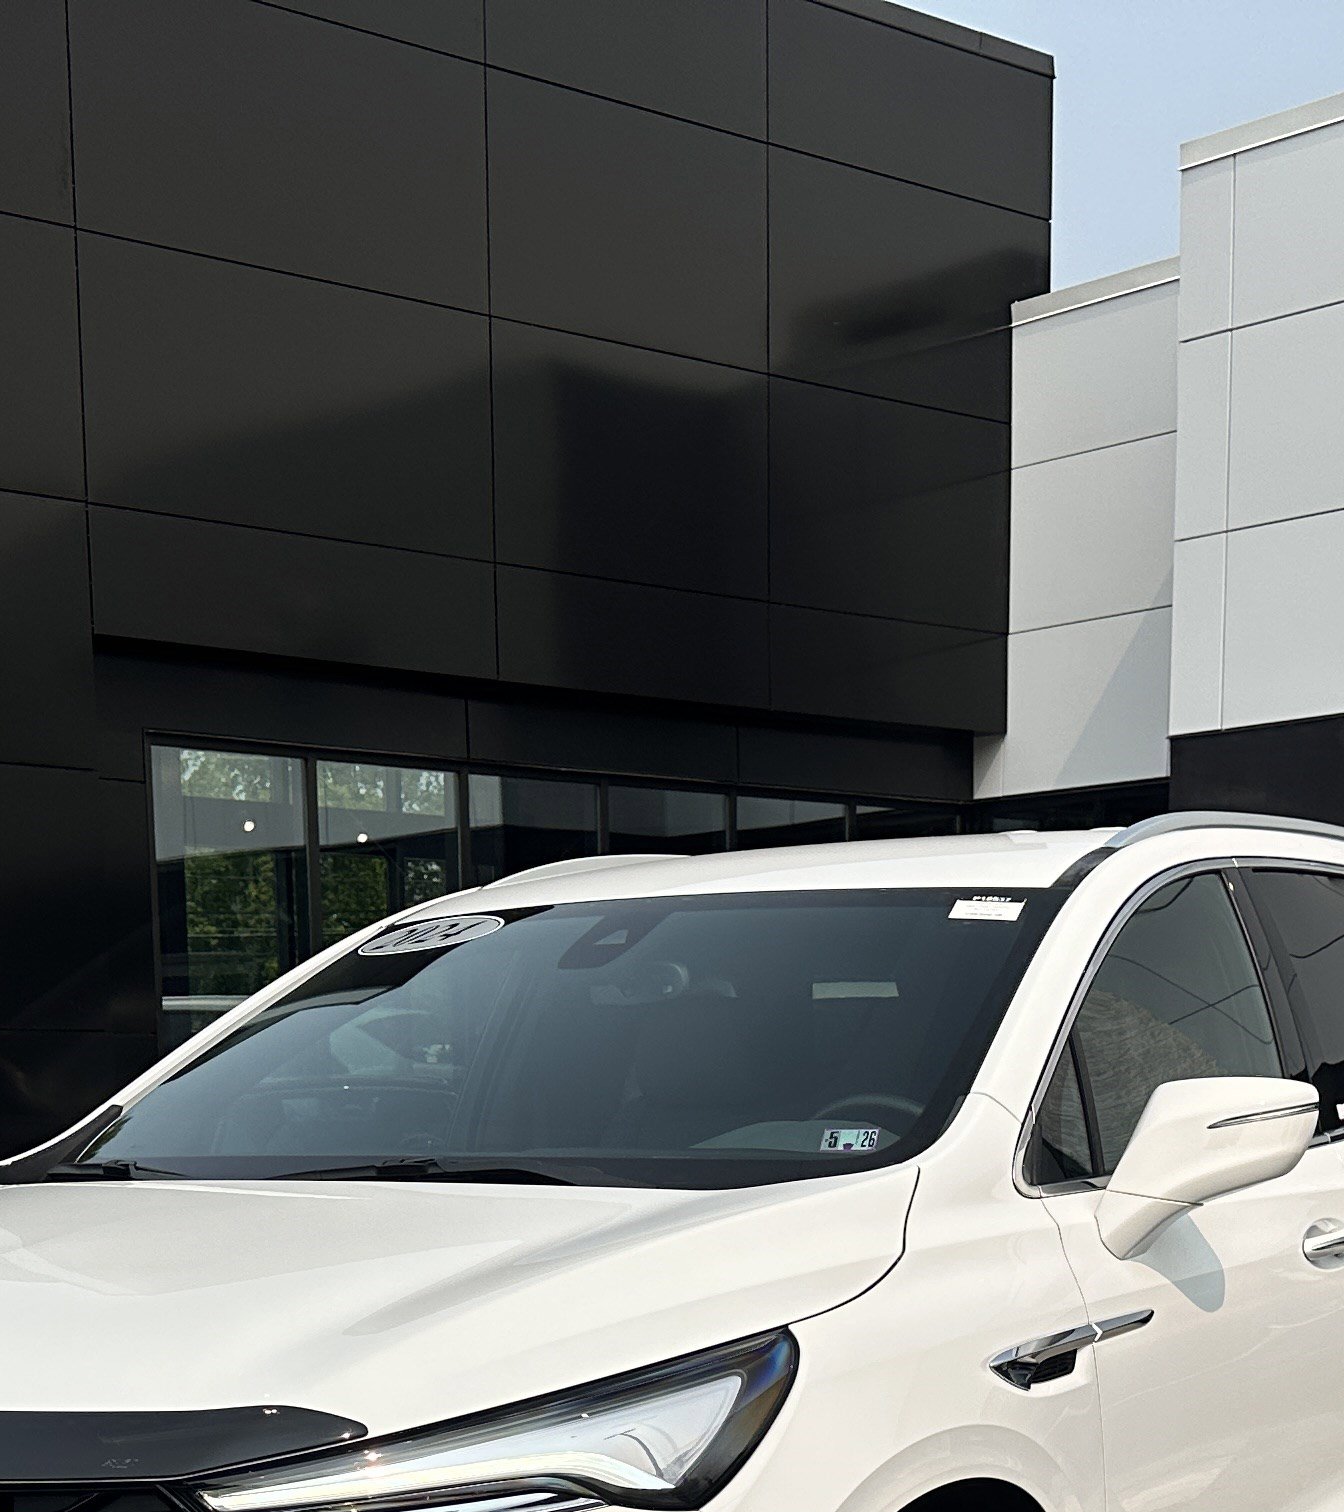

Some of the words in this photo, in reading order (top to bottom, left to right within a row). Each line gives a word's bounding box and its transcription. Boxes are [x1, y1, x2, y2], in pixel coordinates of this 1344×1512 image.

[368, 920, 488, 951] 2024
[828, 1131, 840, 1149] 5
[860, 1131, 877, 1148] 26
